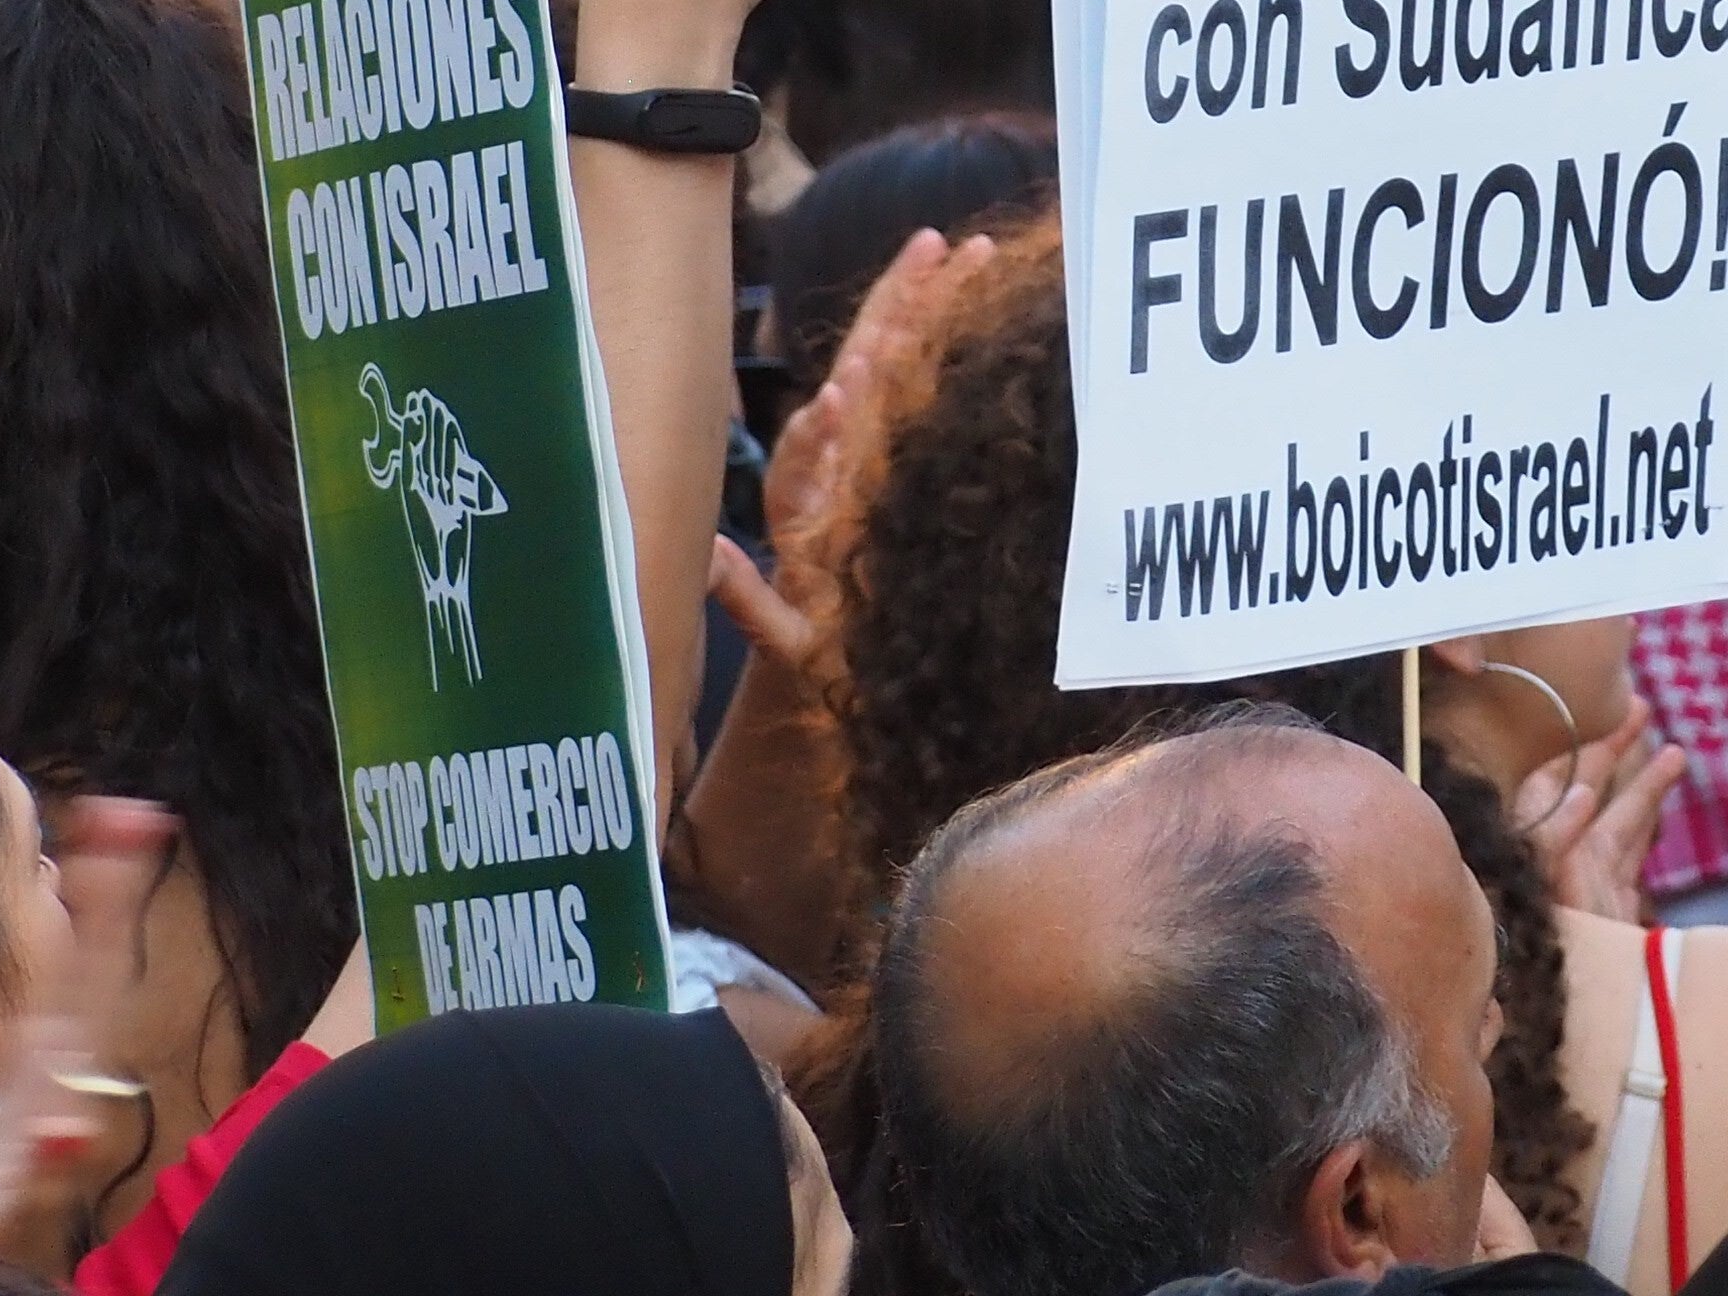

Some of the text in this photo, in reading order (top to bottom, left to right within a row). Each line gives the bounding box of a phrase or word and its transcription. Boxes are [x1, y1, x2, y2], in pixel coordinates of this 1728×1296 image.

[286, 140, 549, 341] CON ISRAEL
[1124, 382, 1715, 623] www.boicotisrael.net
[353, 730, 633, 882] STOP COMERCIO
[413, 883, 597, 1016] DE ARMAS
